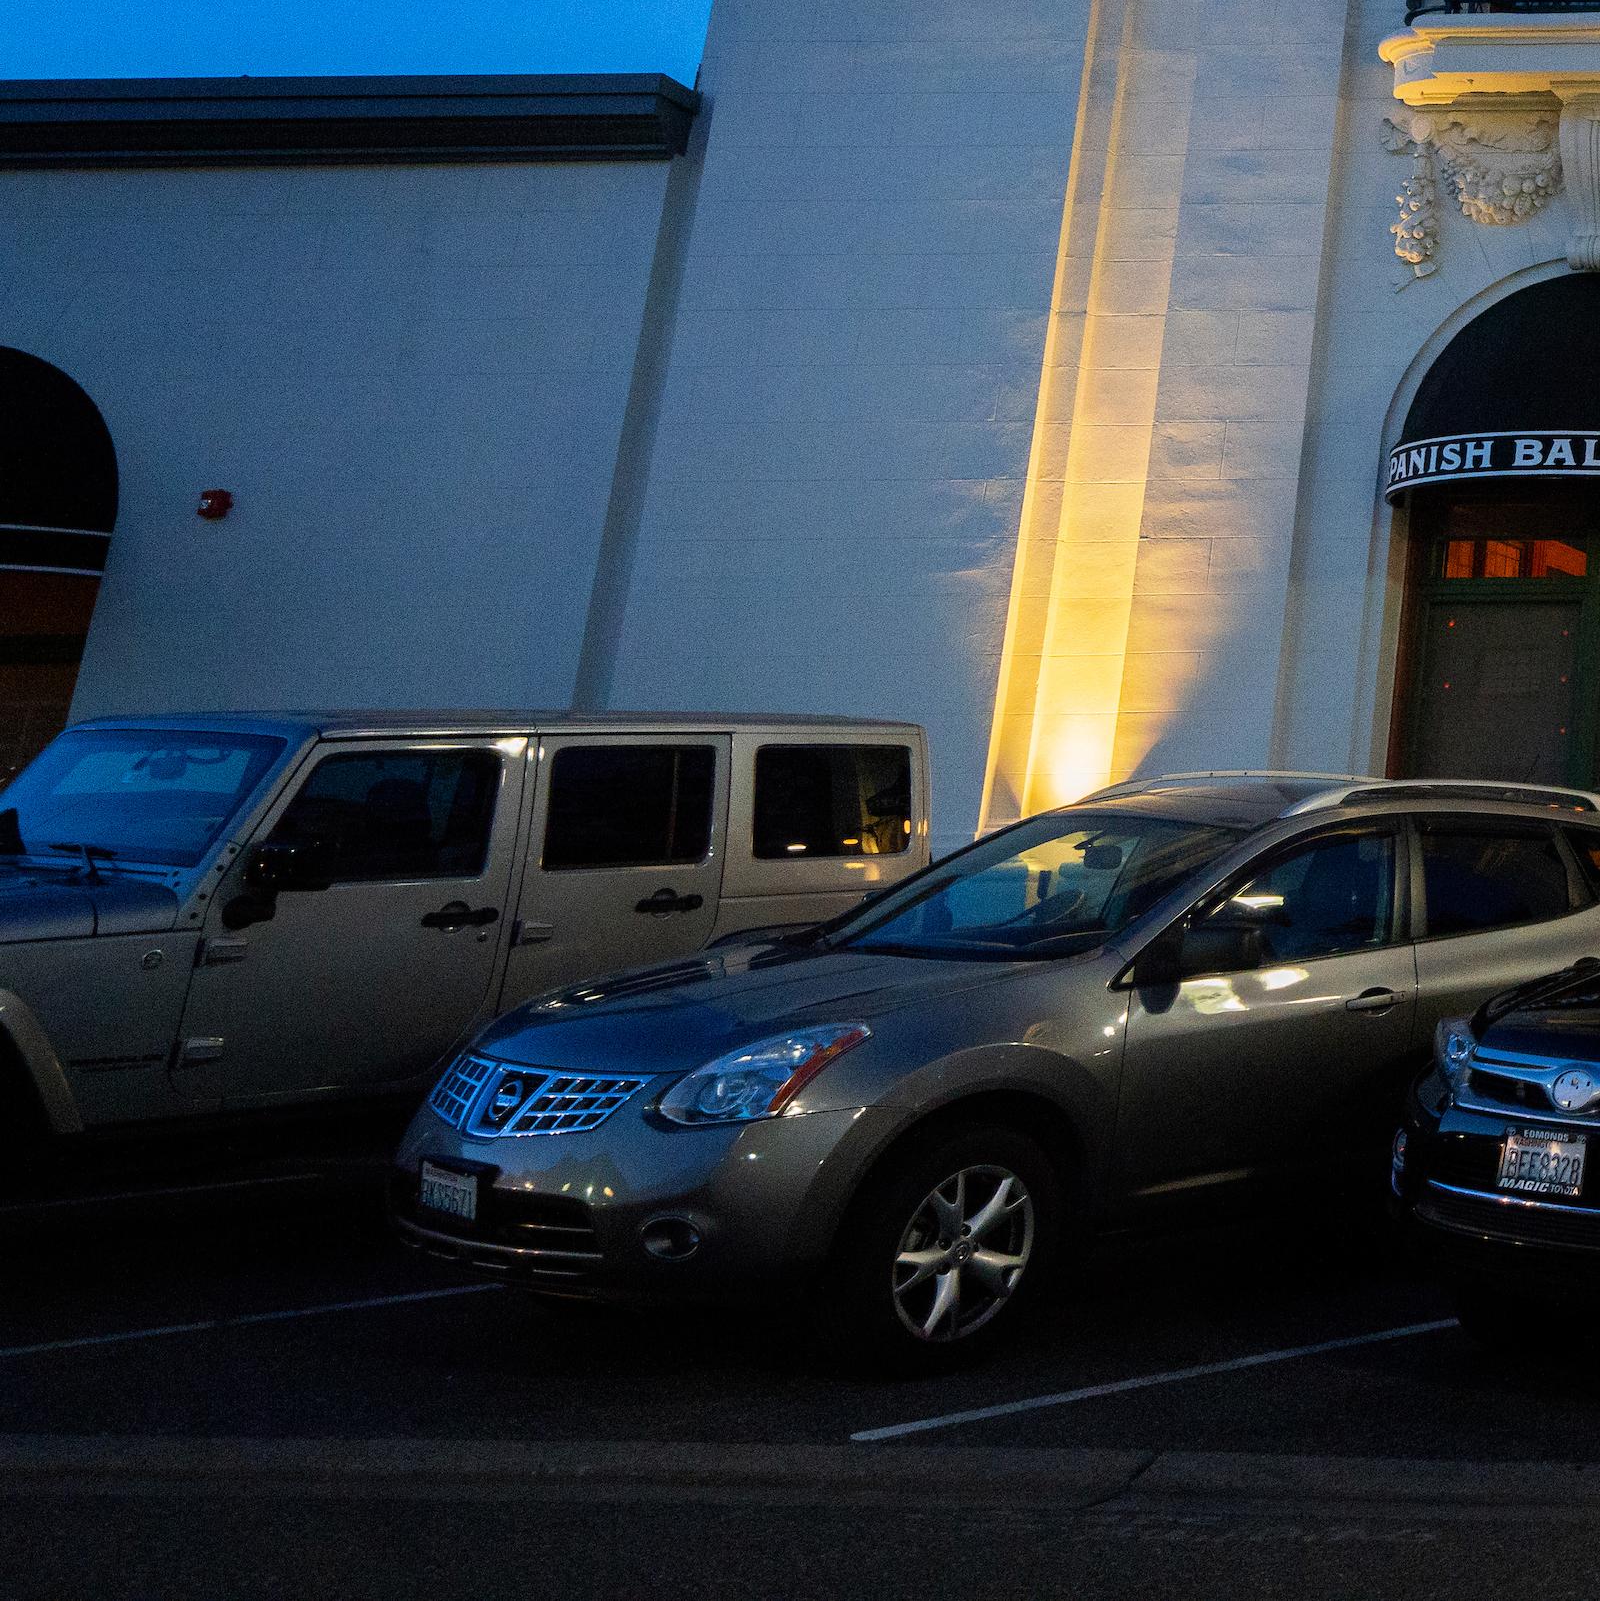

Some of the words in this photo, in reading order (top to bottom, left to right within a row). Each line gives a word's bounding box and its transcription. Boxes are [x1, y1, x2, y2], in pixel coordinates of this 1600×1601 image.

[1523, 1129, 1569, 1142] EDMONDS
[1498, 1177, 1550, 1192] MAGIC
[1550, 1183, 1580, 1196] TOYOTA
